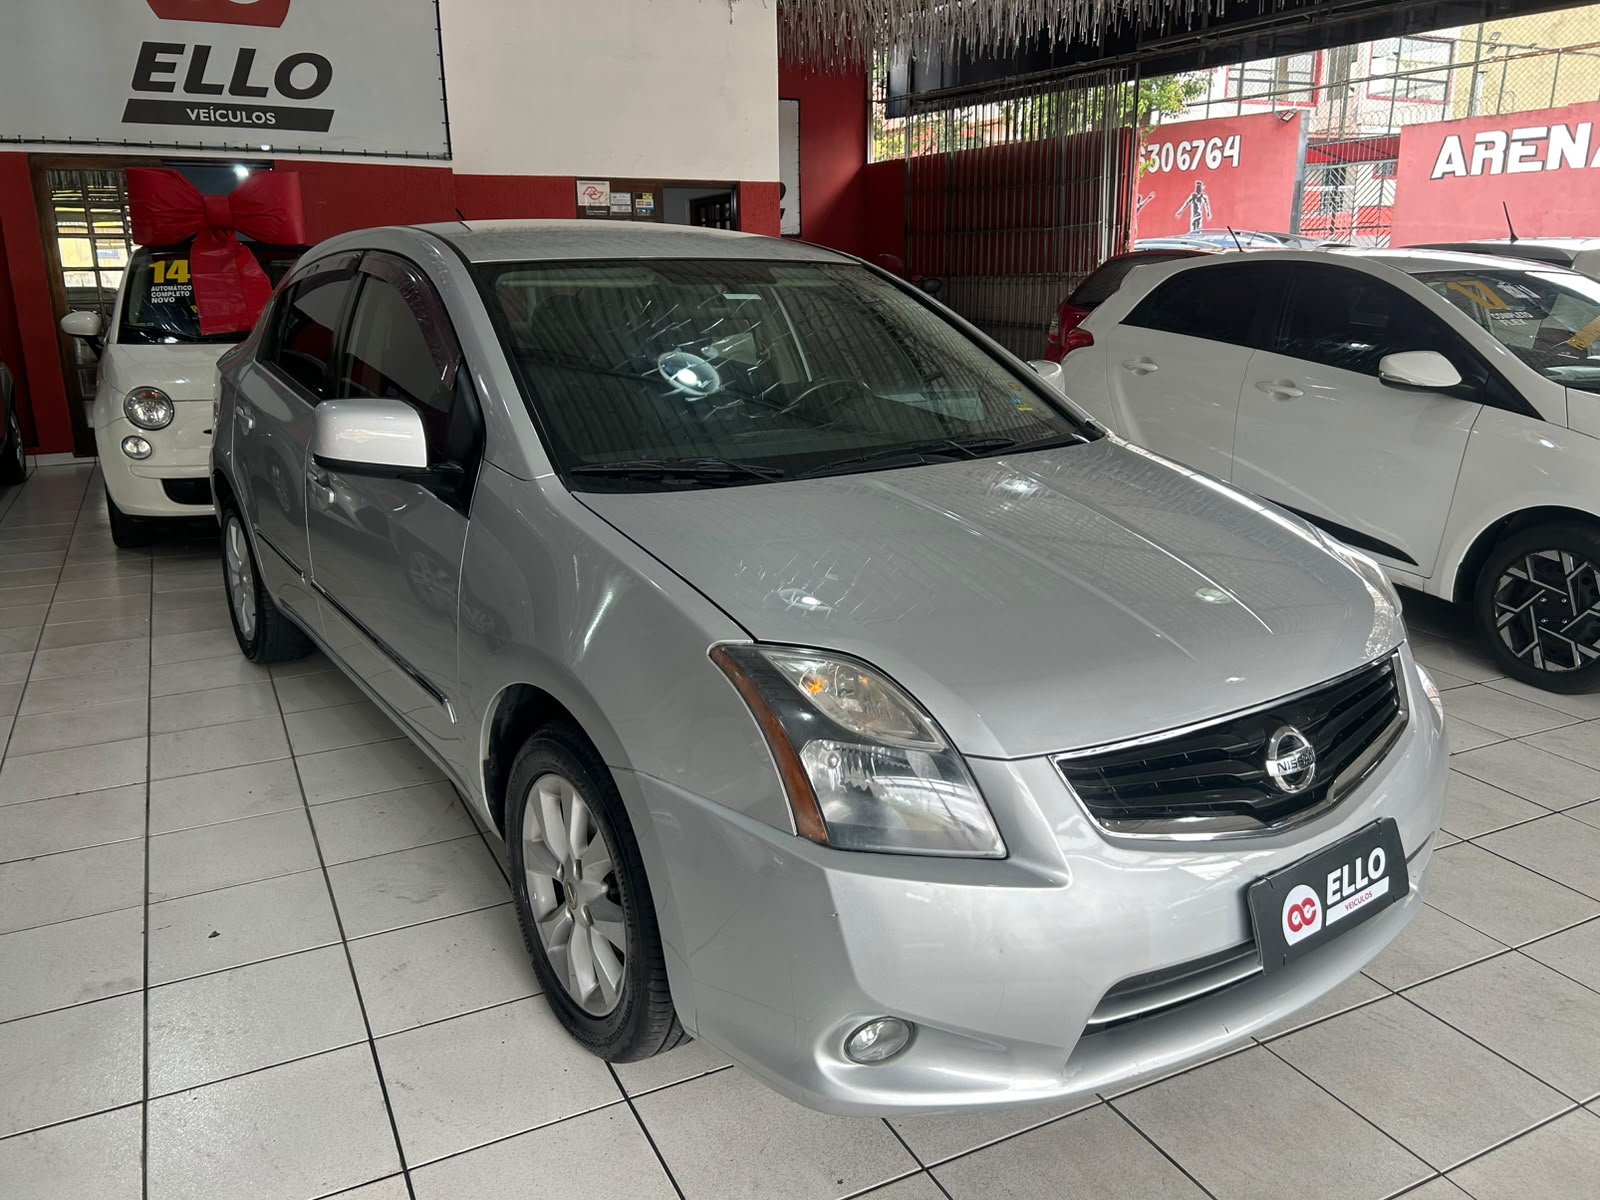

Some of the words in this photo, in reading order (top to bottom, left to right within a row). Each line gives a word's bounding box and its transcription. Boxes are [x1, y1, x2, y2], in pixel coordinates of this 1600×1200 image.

[131, 41, 333, 100] ELLO
[186, 106, 276, 125] VEÍCULOS
[1430, 122, 1600, 180] AREN
[148, 259, 191, 284] 14
[151, 284, 192, 292] AUTOMÁTICO
[1277, 747, 1315, 772] NISSAN
[1326, 847, 1386, 905] ELLO
[1344, 890, 1373, 911] VEÍCULOS
